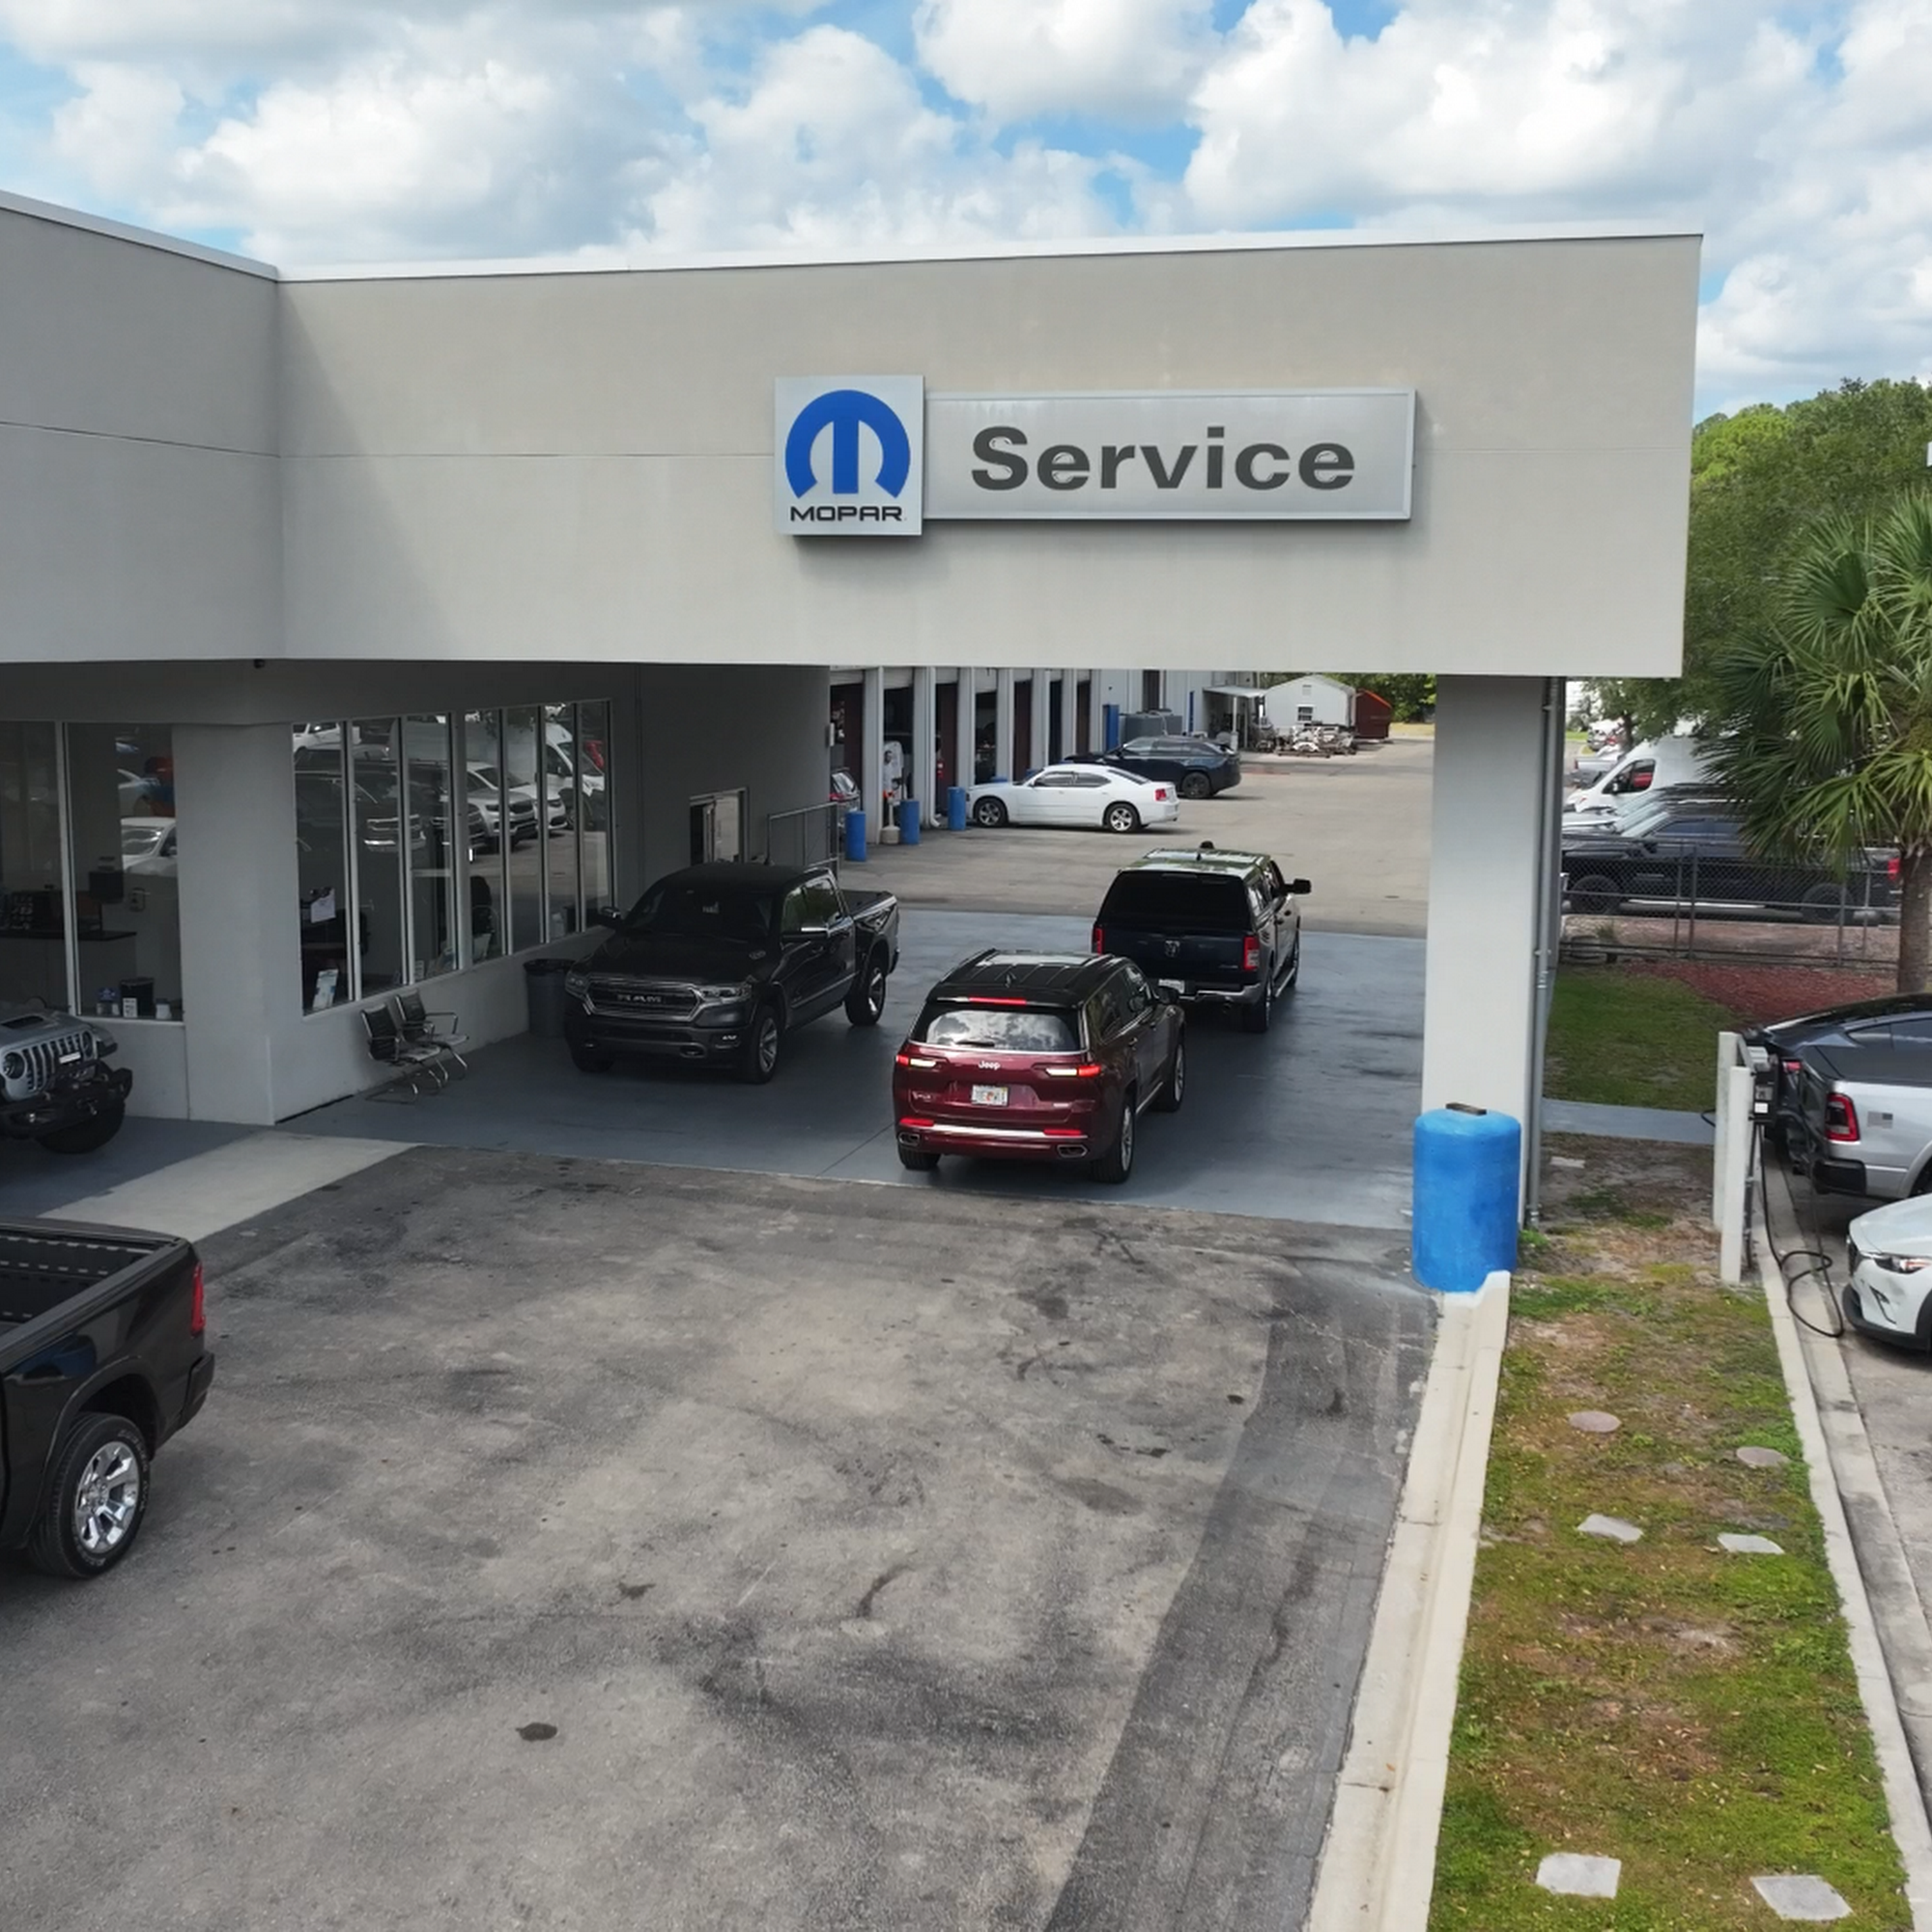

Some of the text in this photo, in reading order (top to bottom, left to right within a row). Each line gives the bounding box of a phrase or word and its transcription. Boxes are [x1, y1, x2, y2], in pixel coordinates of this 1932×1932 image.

[971, 426, 1355, 491] Service
[789, 505, 903, 523] MOPAR
[978, 1060, 1001, 1070] Jeep
